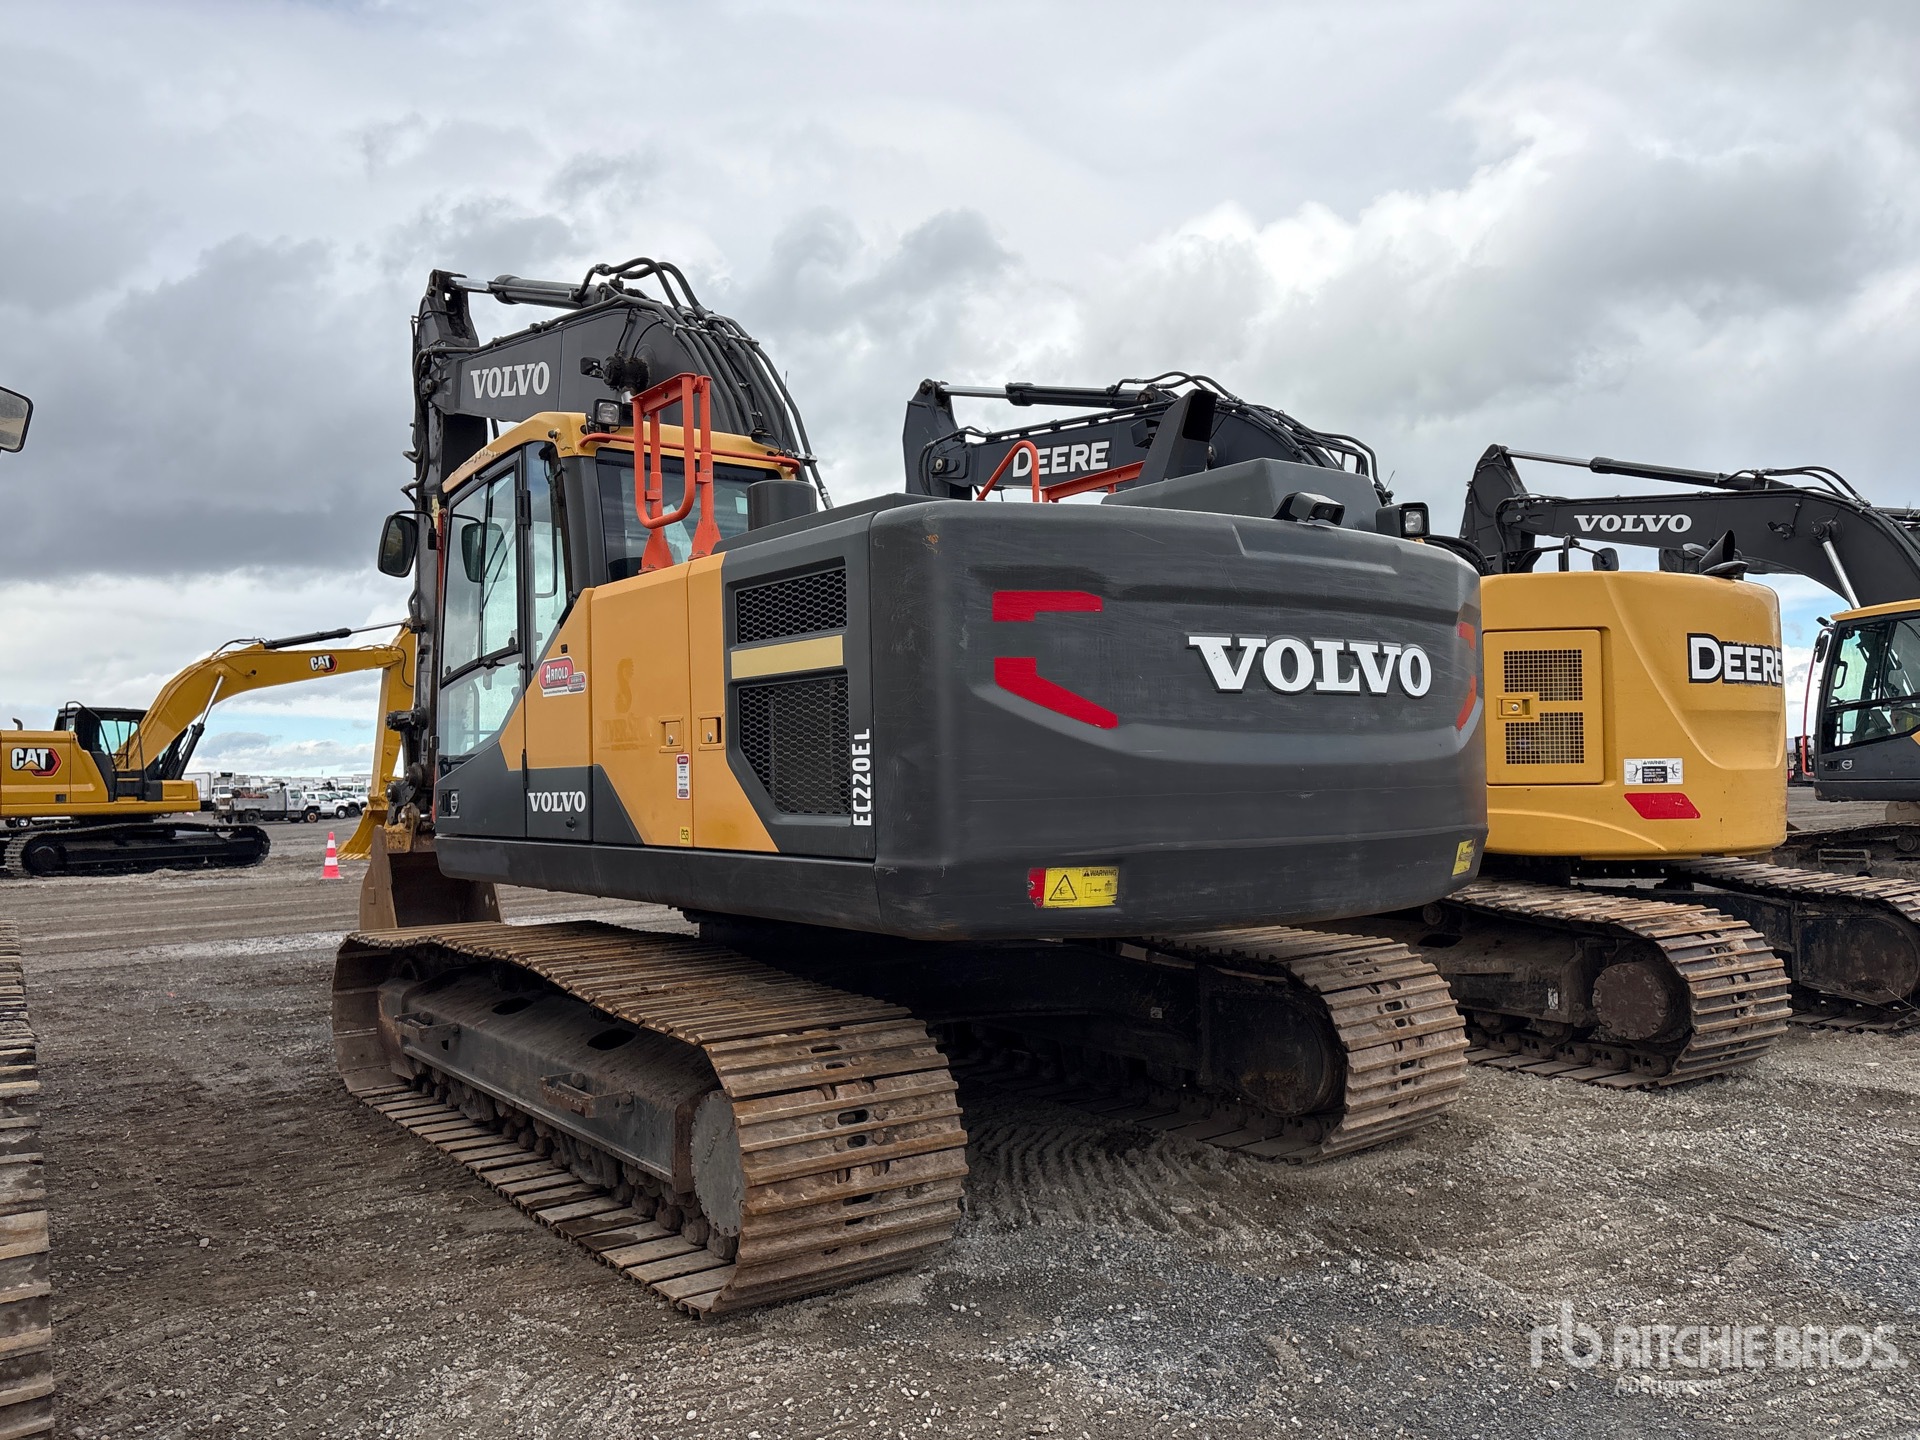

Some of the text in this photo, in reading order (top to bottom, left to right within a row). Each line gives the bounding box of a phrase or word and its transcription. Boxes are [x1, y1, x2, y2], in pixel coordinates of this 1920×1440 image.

[470, 361, 551, 399] VOLVO
[1012, 442, 1110, 477] DEERE
[1573, 513, 1693, 534] VOLVO
[310, 655, 331, 671] CAT
[1187, 636, 1433, 697] VOLVO
[1690, 636, 1783, 684] DEERE
[11, 748, 49, 770] CAT
[851, 728, 872, 826] EC220EL
[527, 790, 586, 813] VOLVO
[1090, 869, 1117, 877] WARNING
